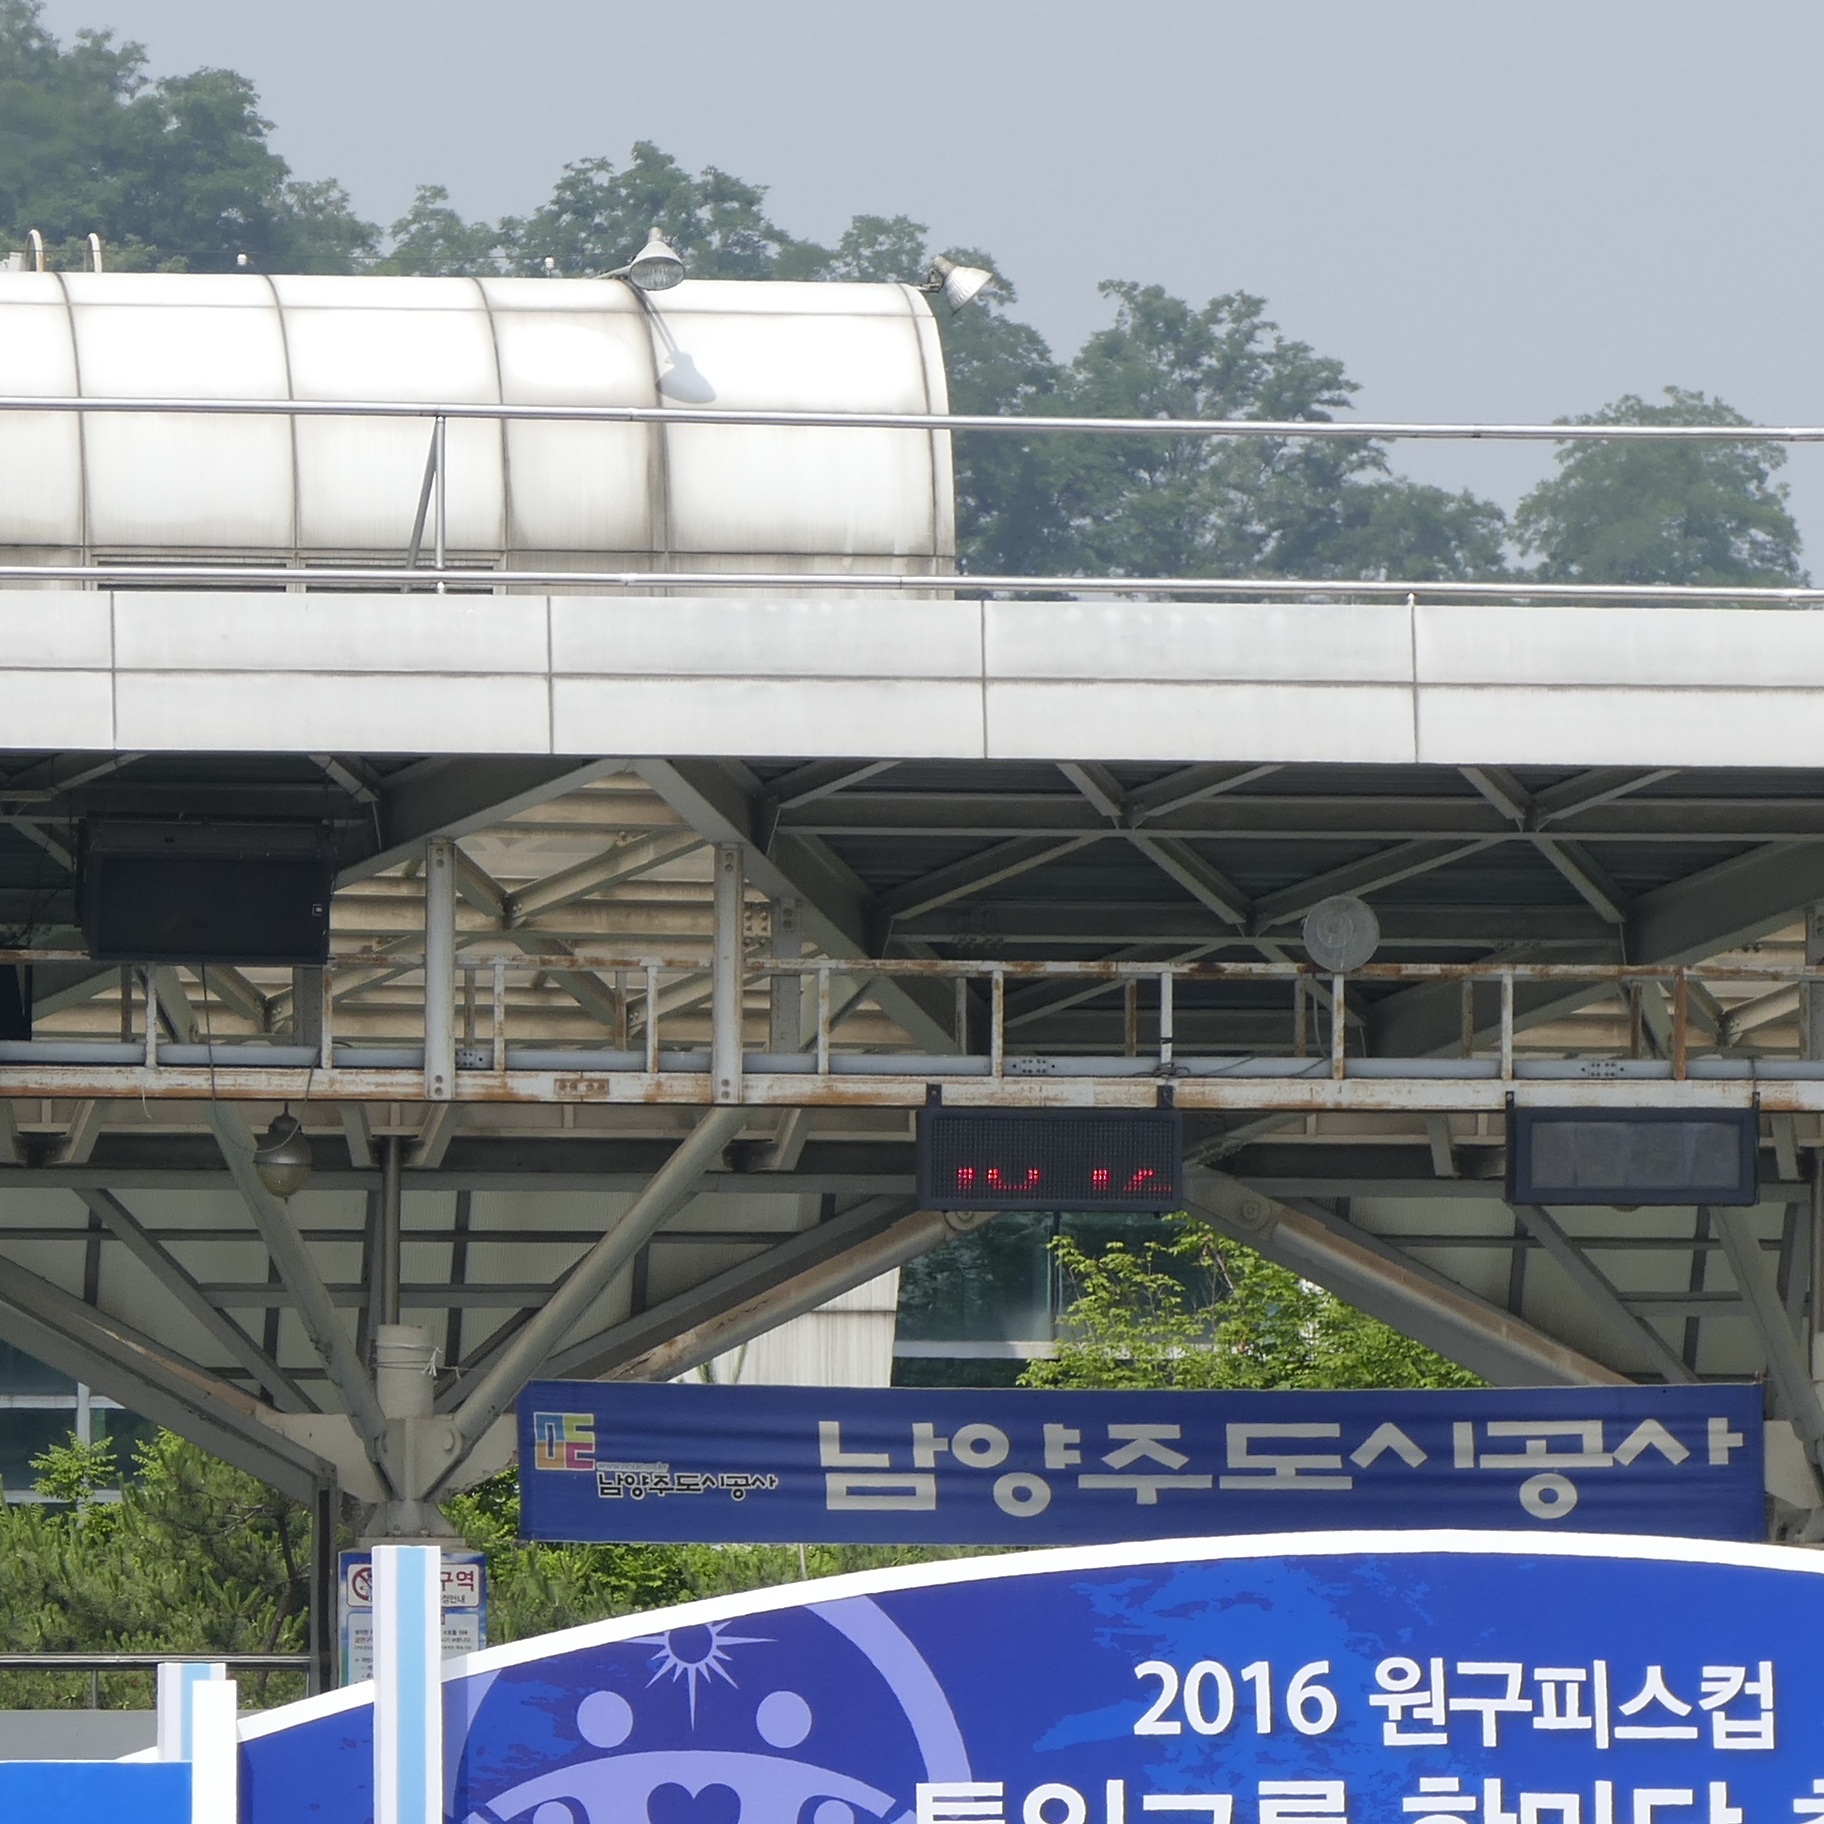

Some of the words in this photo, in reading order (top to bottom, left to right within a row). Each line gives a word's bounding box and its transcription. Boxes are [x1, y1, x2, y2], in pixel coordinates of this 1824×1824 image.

[596, 1471, 779, 1501] 남양주도시공사
[817, 1416, 1747, 1520] 남양주도시공사
[1133, 1661, 1336, 1736] 2016
[1369, 1657, 1776, 1751] 원구피스컵
